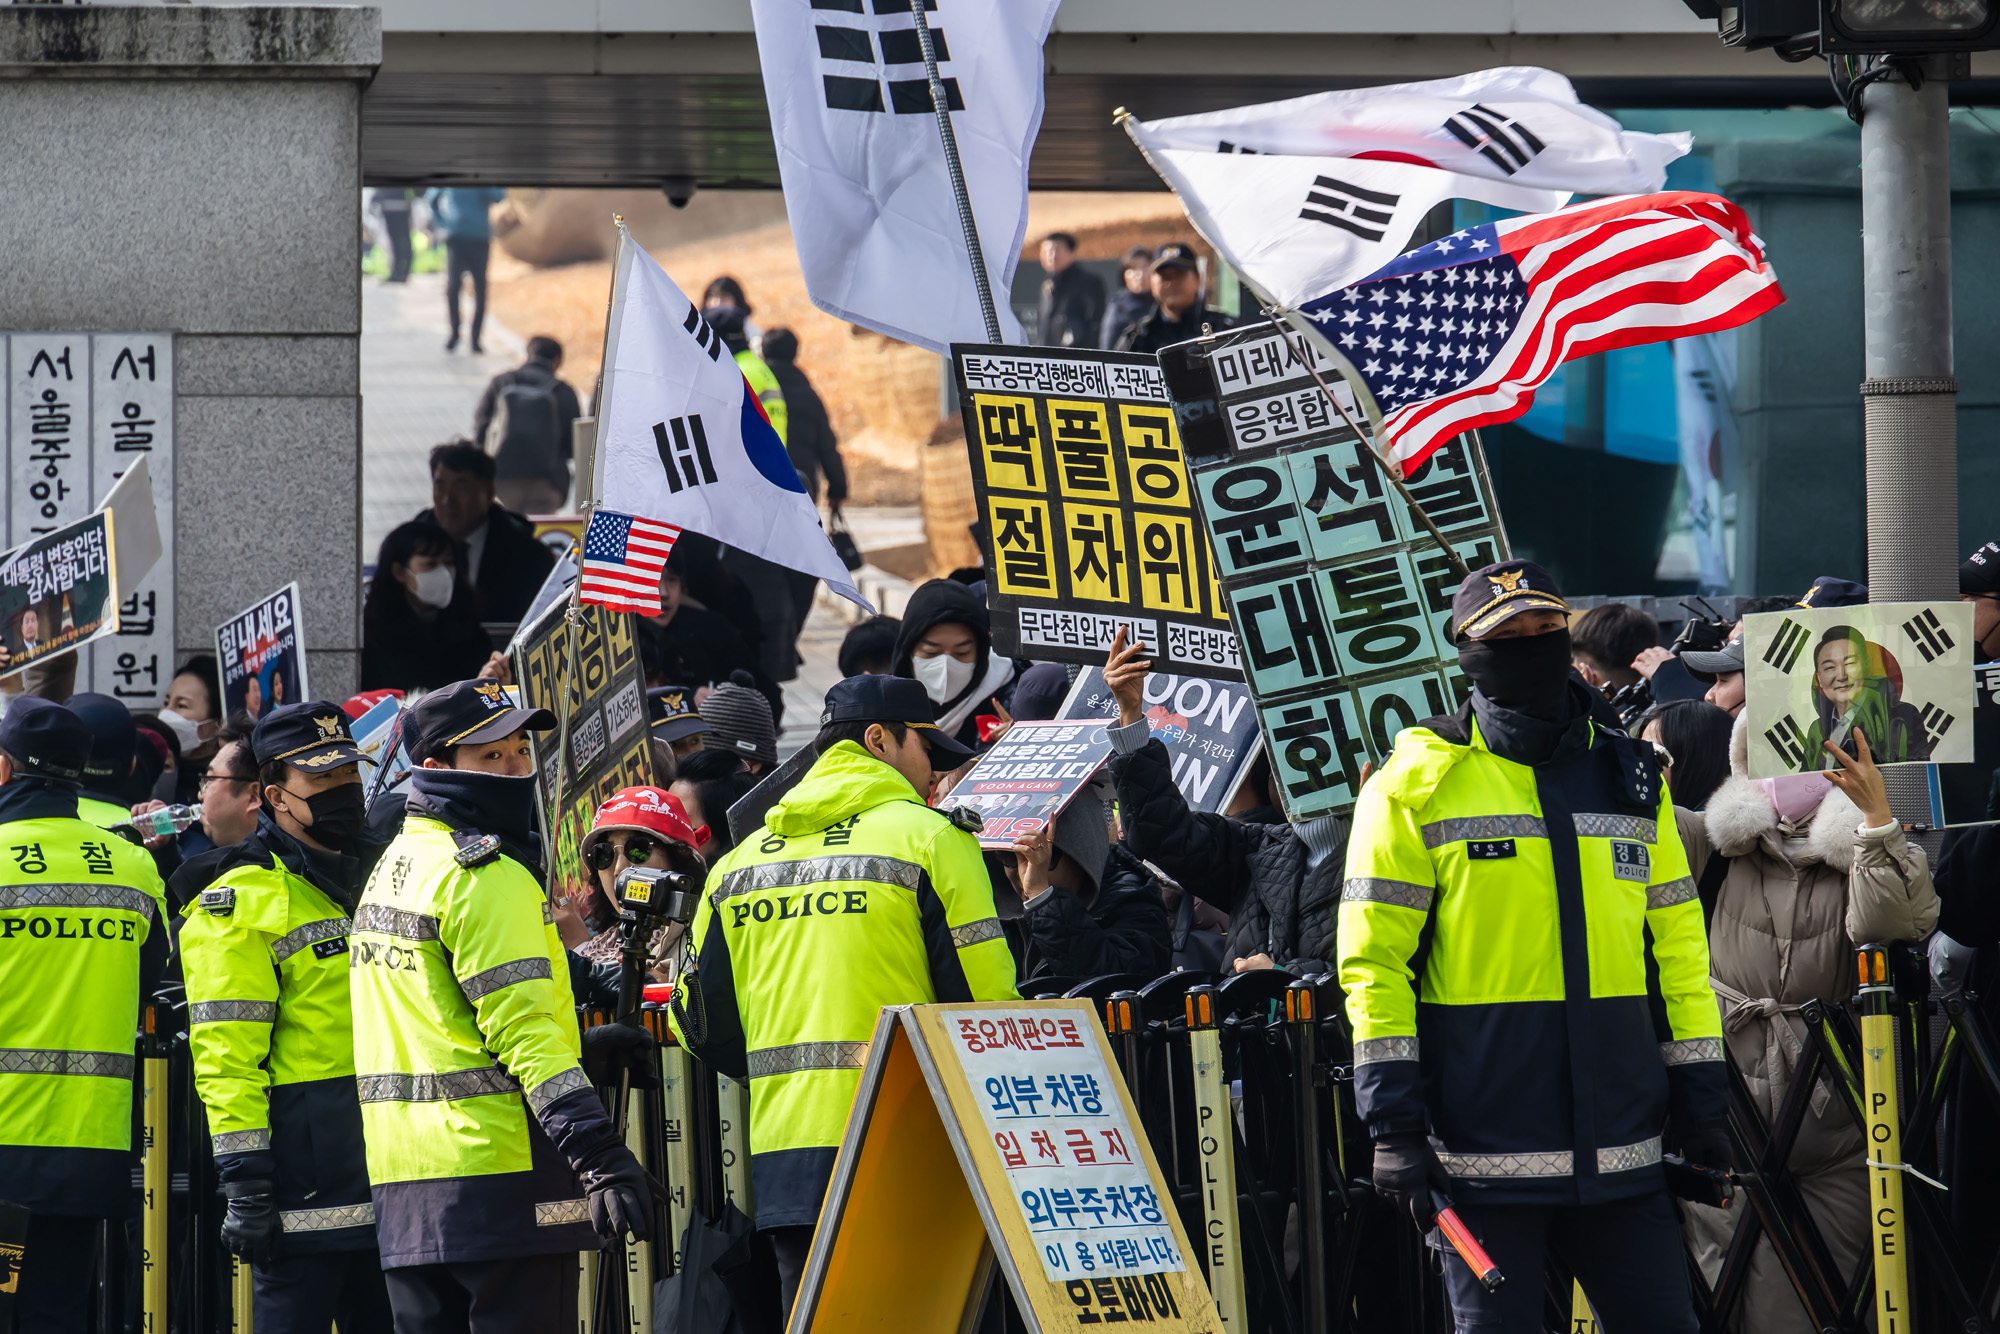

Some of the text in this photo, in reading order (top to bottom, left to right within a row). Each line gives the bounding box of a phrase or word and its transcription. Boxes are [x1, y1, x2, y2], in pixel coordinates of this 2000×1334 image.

[964, 358, 1167, 399] 특수공무집행방해 ,직권남
[1218, 334, 1326, 385] 미래세
[1235, 385, 1364, 443] 응원합니
[28, 345, 73, 533] 서울중앙
[979, 403, 1181, 499] 딱풀공
[111, 345, 157, 698] 서울법원
[3, 526, 103, 587] 대통령 변호인단
[27, 552, 106, 605] 감사합니다
[995, 505, 1227, 613] 절차위
[219, 594, 292, 668] 힘내세요
[607, 685, 641, 733] 기소하라
[1142, 672, 1248, 734] OON
[986, 743, 1089, 762] 변호인단
[1002, 726, 1085, 743] 대통령
[1161, 723, 1197, 749] 우리가
[1199, 739, 1235, 763] 지킨다
[968, 761, 1099, 781] 감사합니다
[979, 782, 1057, 790] YOON AGAIN
[10, 841, 114, 875] 경찰
[1616, 844, 1647, 866] 경찰
[1617, 865, 1647, 878] POLICE
[1, 917, 136, 941] POLICE
[730, 890, 867, 928] POLICE
[957, 1017, 1085, 1054] 중요재판으로
[985, 1073, 1104, 1116] 외부 차량
[721, 1119, 736, 1198] POL
[1871, 1092, 1896, 1256] POLICE
[1199, 1105, 1225, 1267] POLICE
[1099, 1236, 1182, 1269] 바랍니다.
[1066, 1272, 1182, 1325] 오토바이
